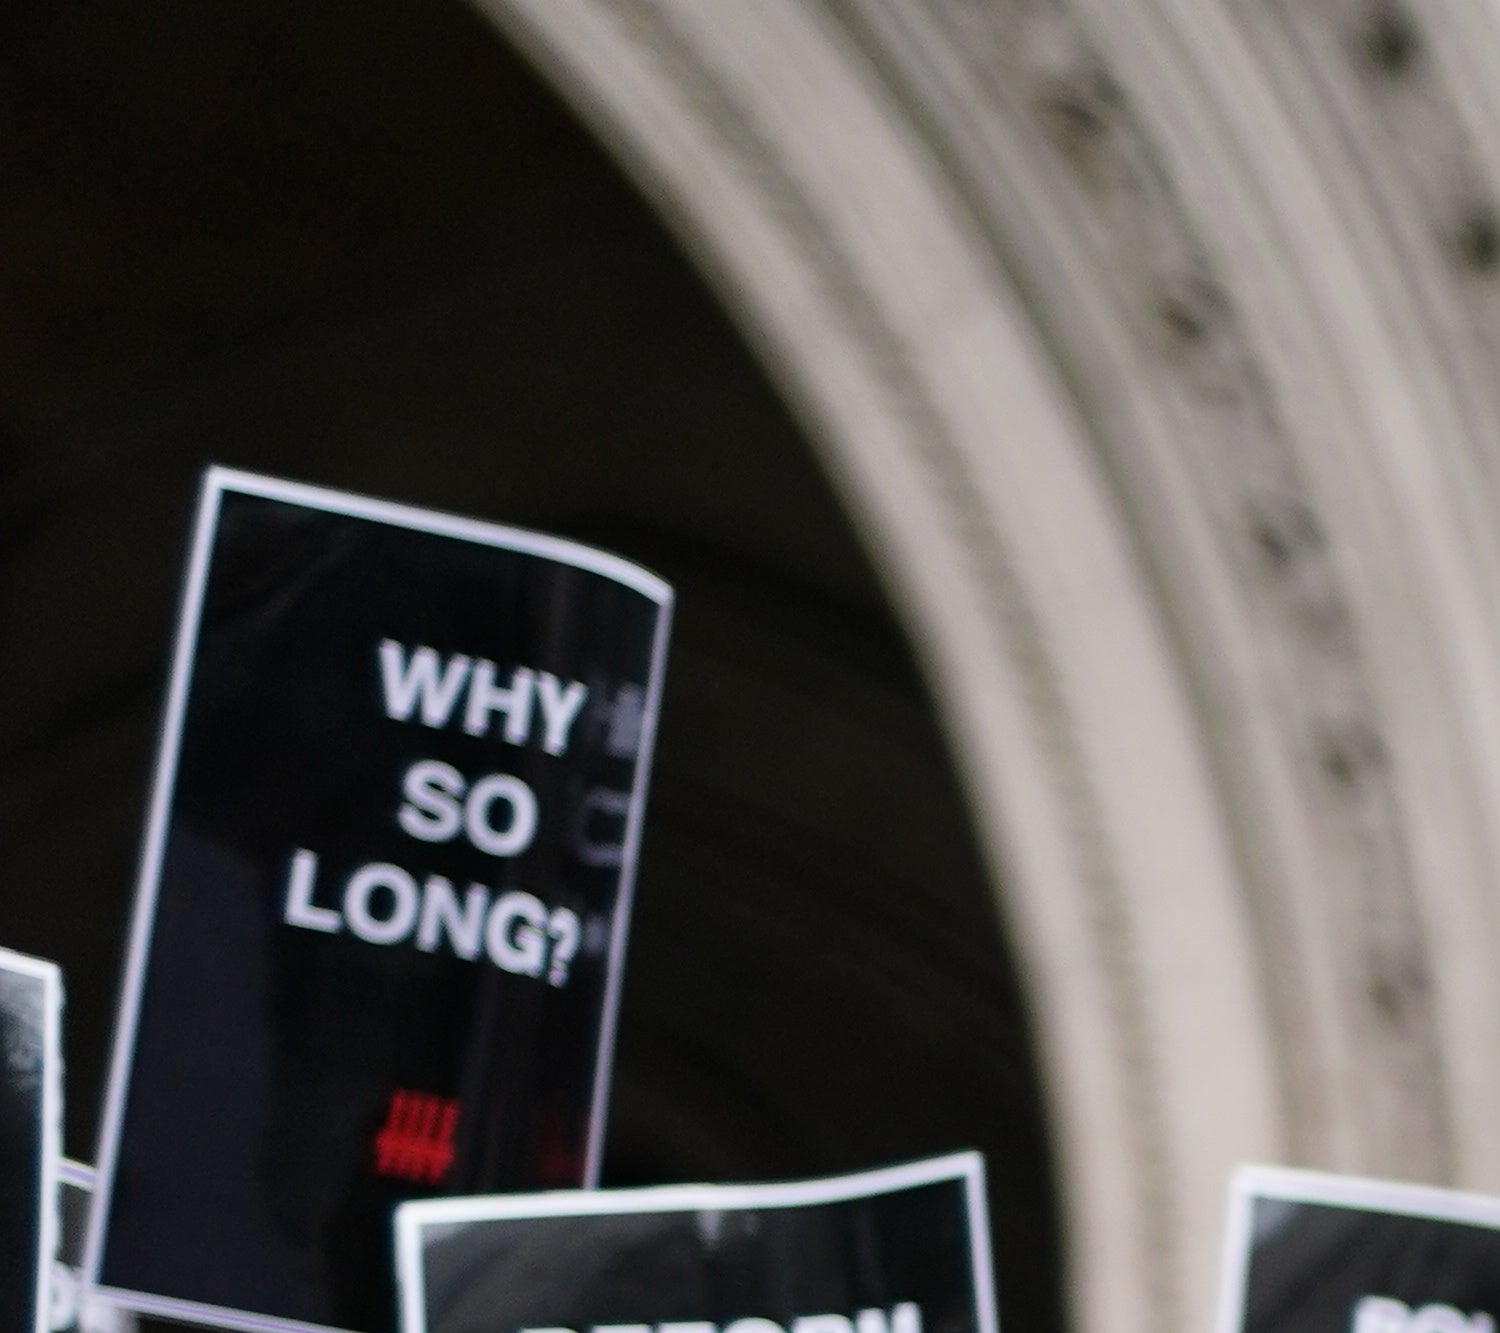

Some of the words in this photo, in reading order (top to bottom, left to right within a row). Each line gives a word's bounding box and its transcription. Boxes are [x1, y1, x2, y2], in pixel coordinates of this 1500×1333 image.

[380, 640, 587, 758] WHY
[397, 760, 538, 857] SO
[283, 848, 581, 988] LONG?
